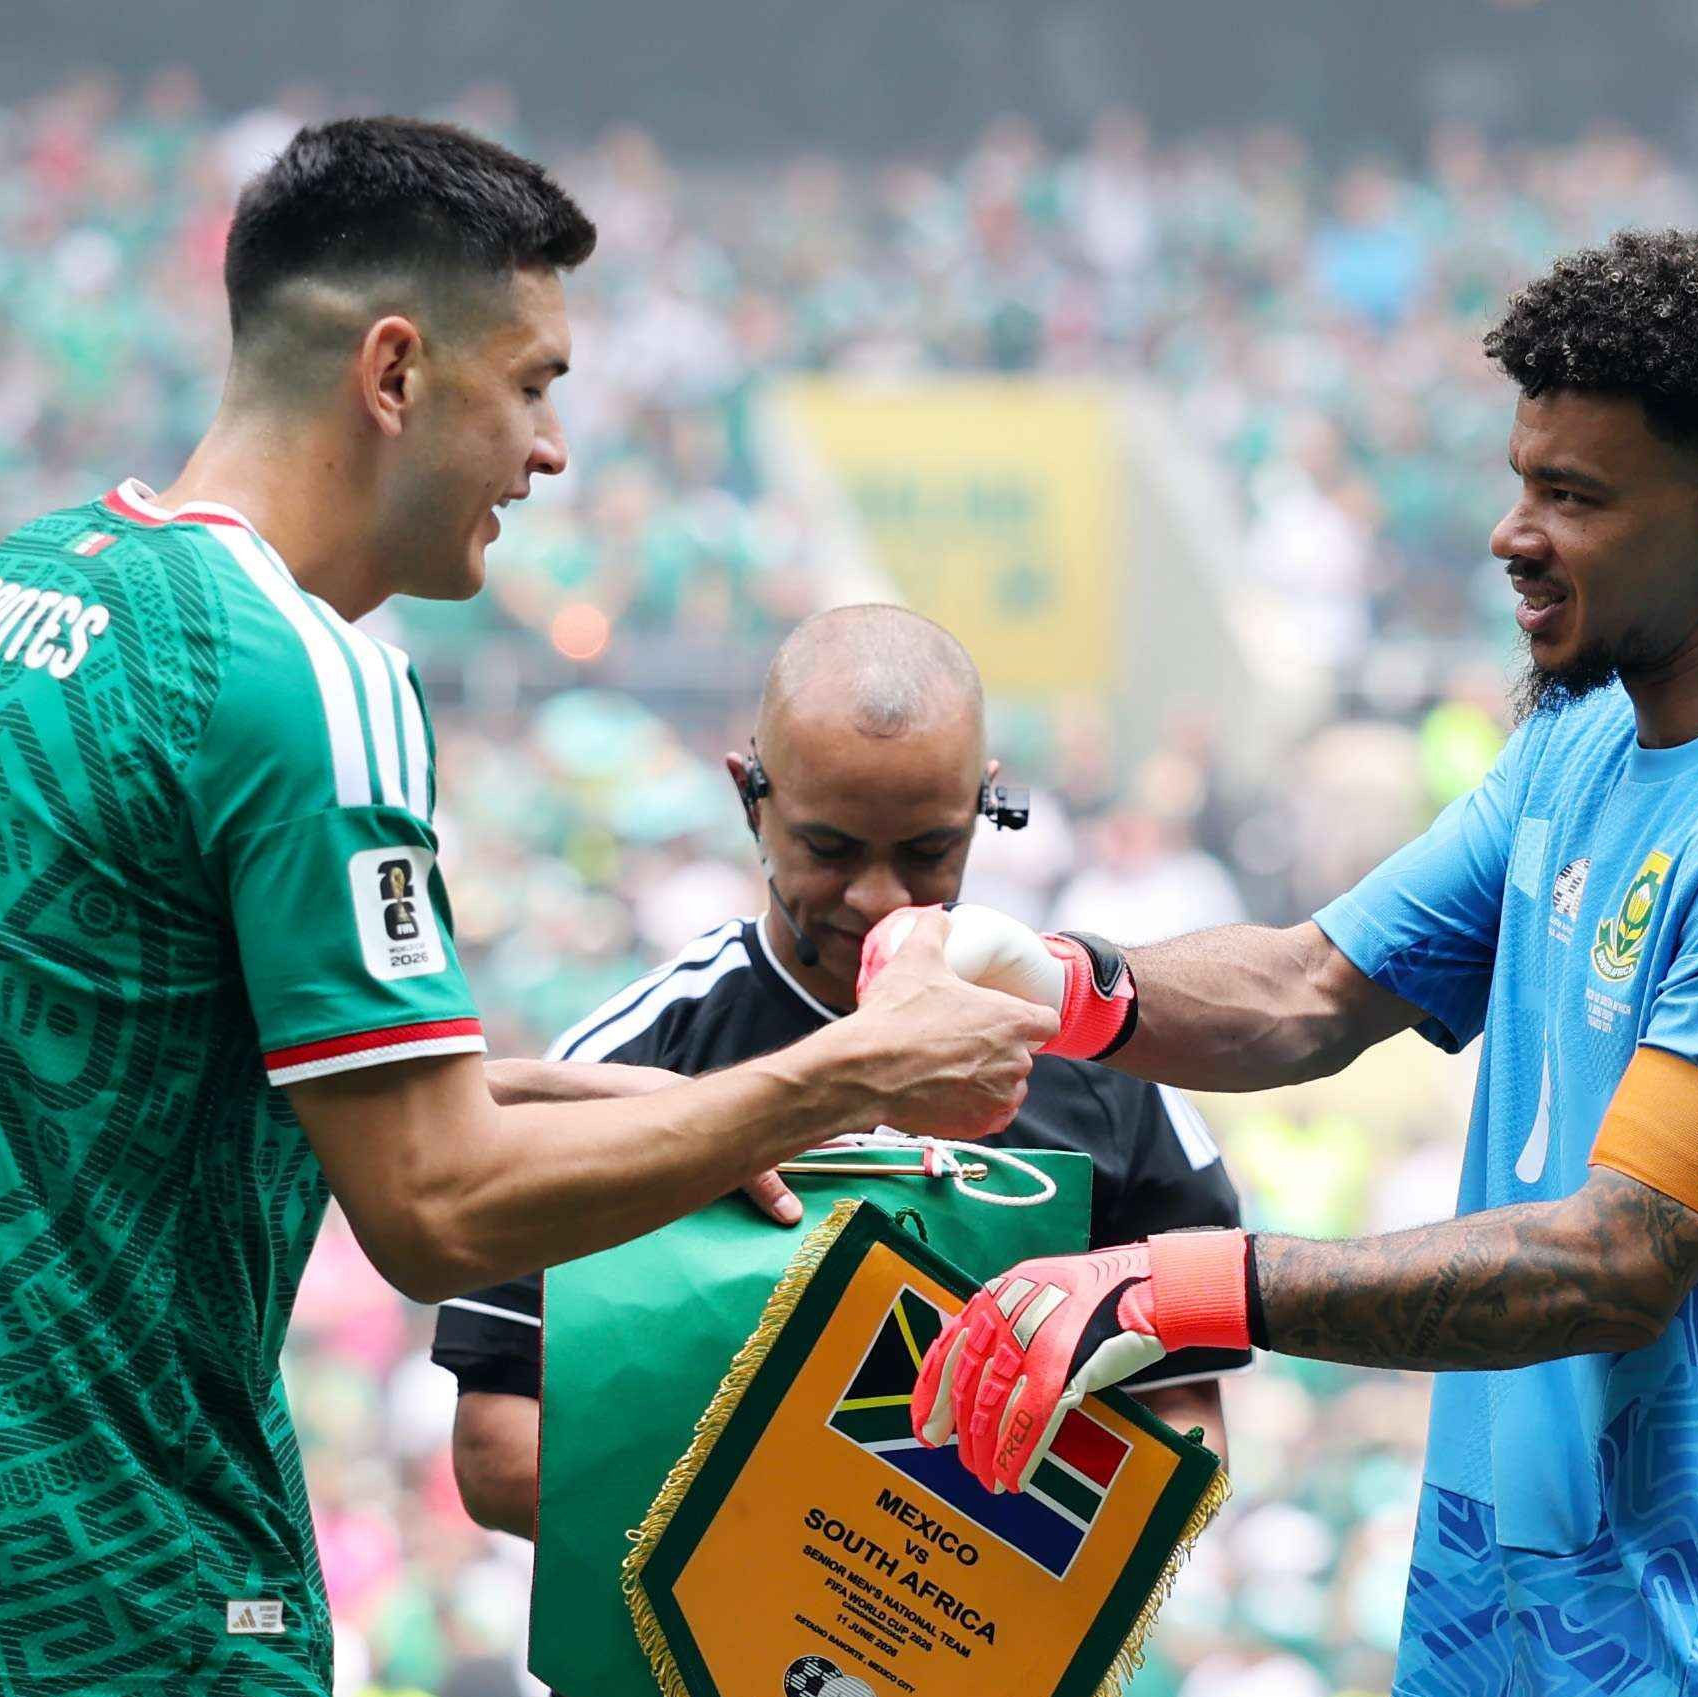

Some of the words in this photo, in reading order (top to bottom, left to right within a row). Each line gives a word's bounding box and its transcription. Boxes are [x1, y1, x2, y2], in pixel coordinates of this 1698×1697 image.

[390, 952, 429, 968] 2026
[875, 1488, 979, 1566] MEXICO
[803, 1545, 847, 1578] SENIOR
[846, 1572, 883, 1600] MEN'S
[883, 1594, 937, 1637] NATIONAL
[940, 1632, 971, 1659] TEAM
[804, 1508, 900, 1578] SOUTH
[898, 1571, 997, 1646] AFRICA
[824, 1578, 848, 1598] FIFA
[848, 1591, 886, 1623] WORLD
[887, 1617, 909, 1637] CUP
[836, 1613, 848, 1626] 11
[848, 1622, 874, 1643] JUNE
[874, 1638, 899, 1658] 2026
